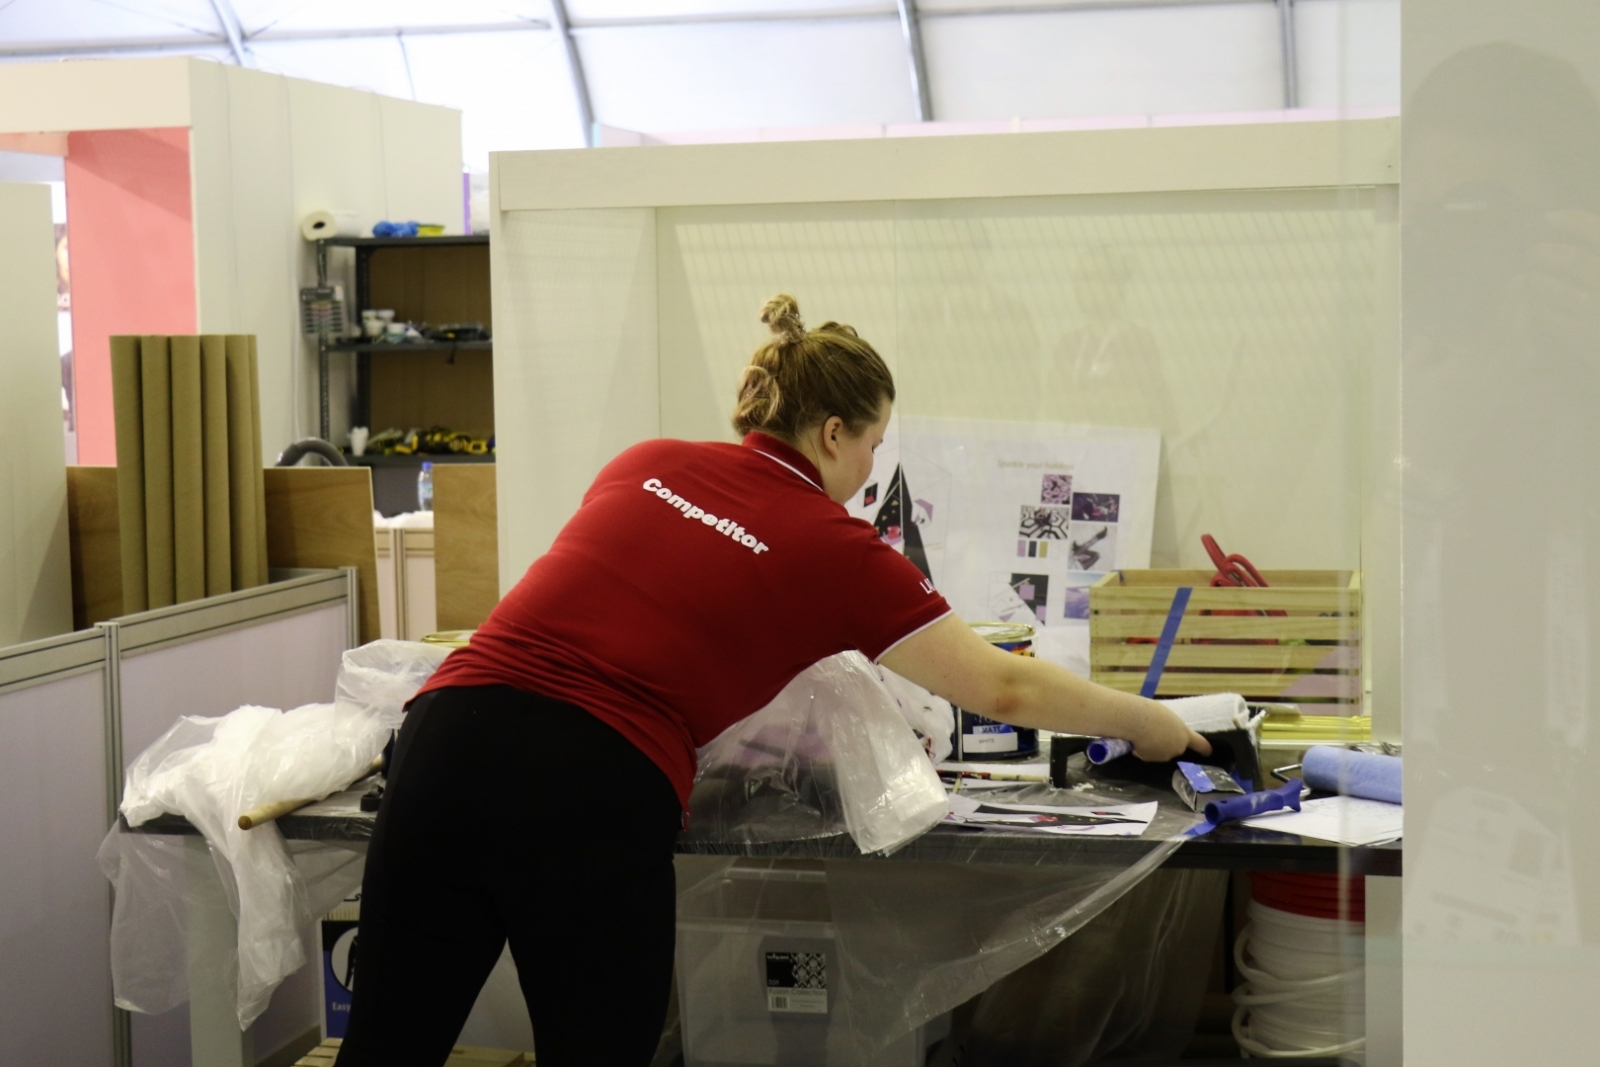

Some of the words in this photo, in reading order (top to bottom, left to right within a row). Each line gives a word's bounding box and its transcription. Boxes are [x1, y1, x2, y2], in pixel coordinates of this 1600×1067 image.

[1027, 462, 1043, 470] your
[642, 477, 770, 555] Competitor
[791, 988, 827, 996] Collection
